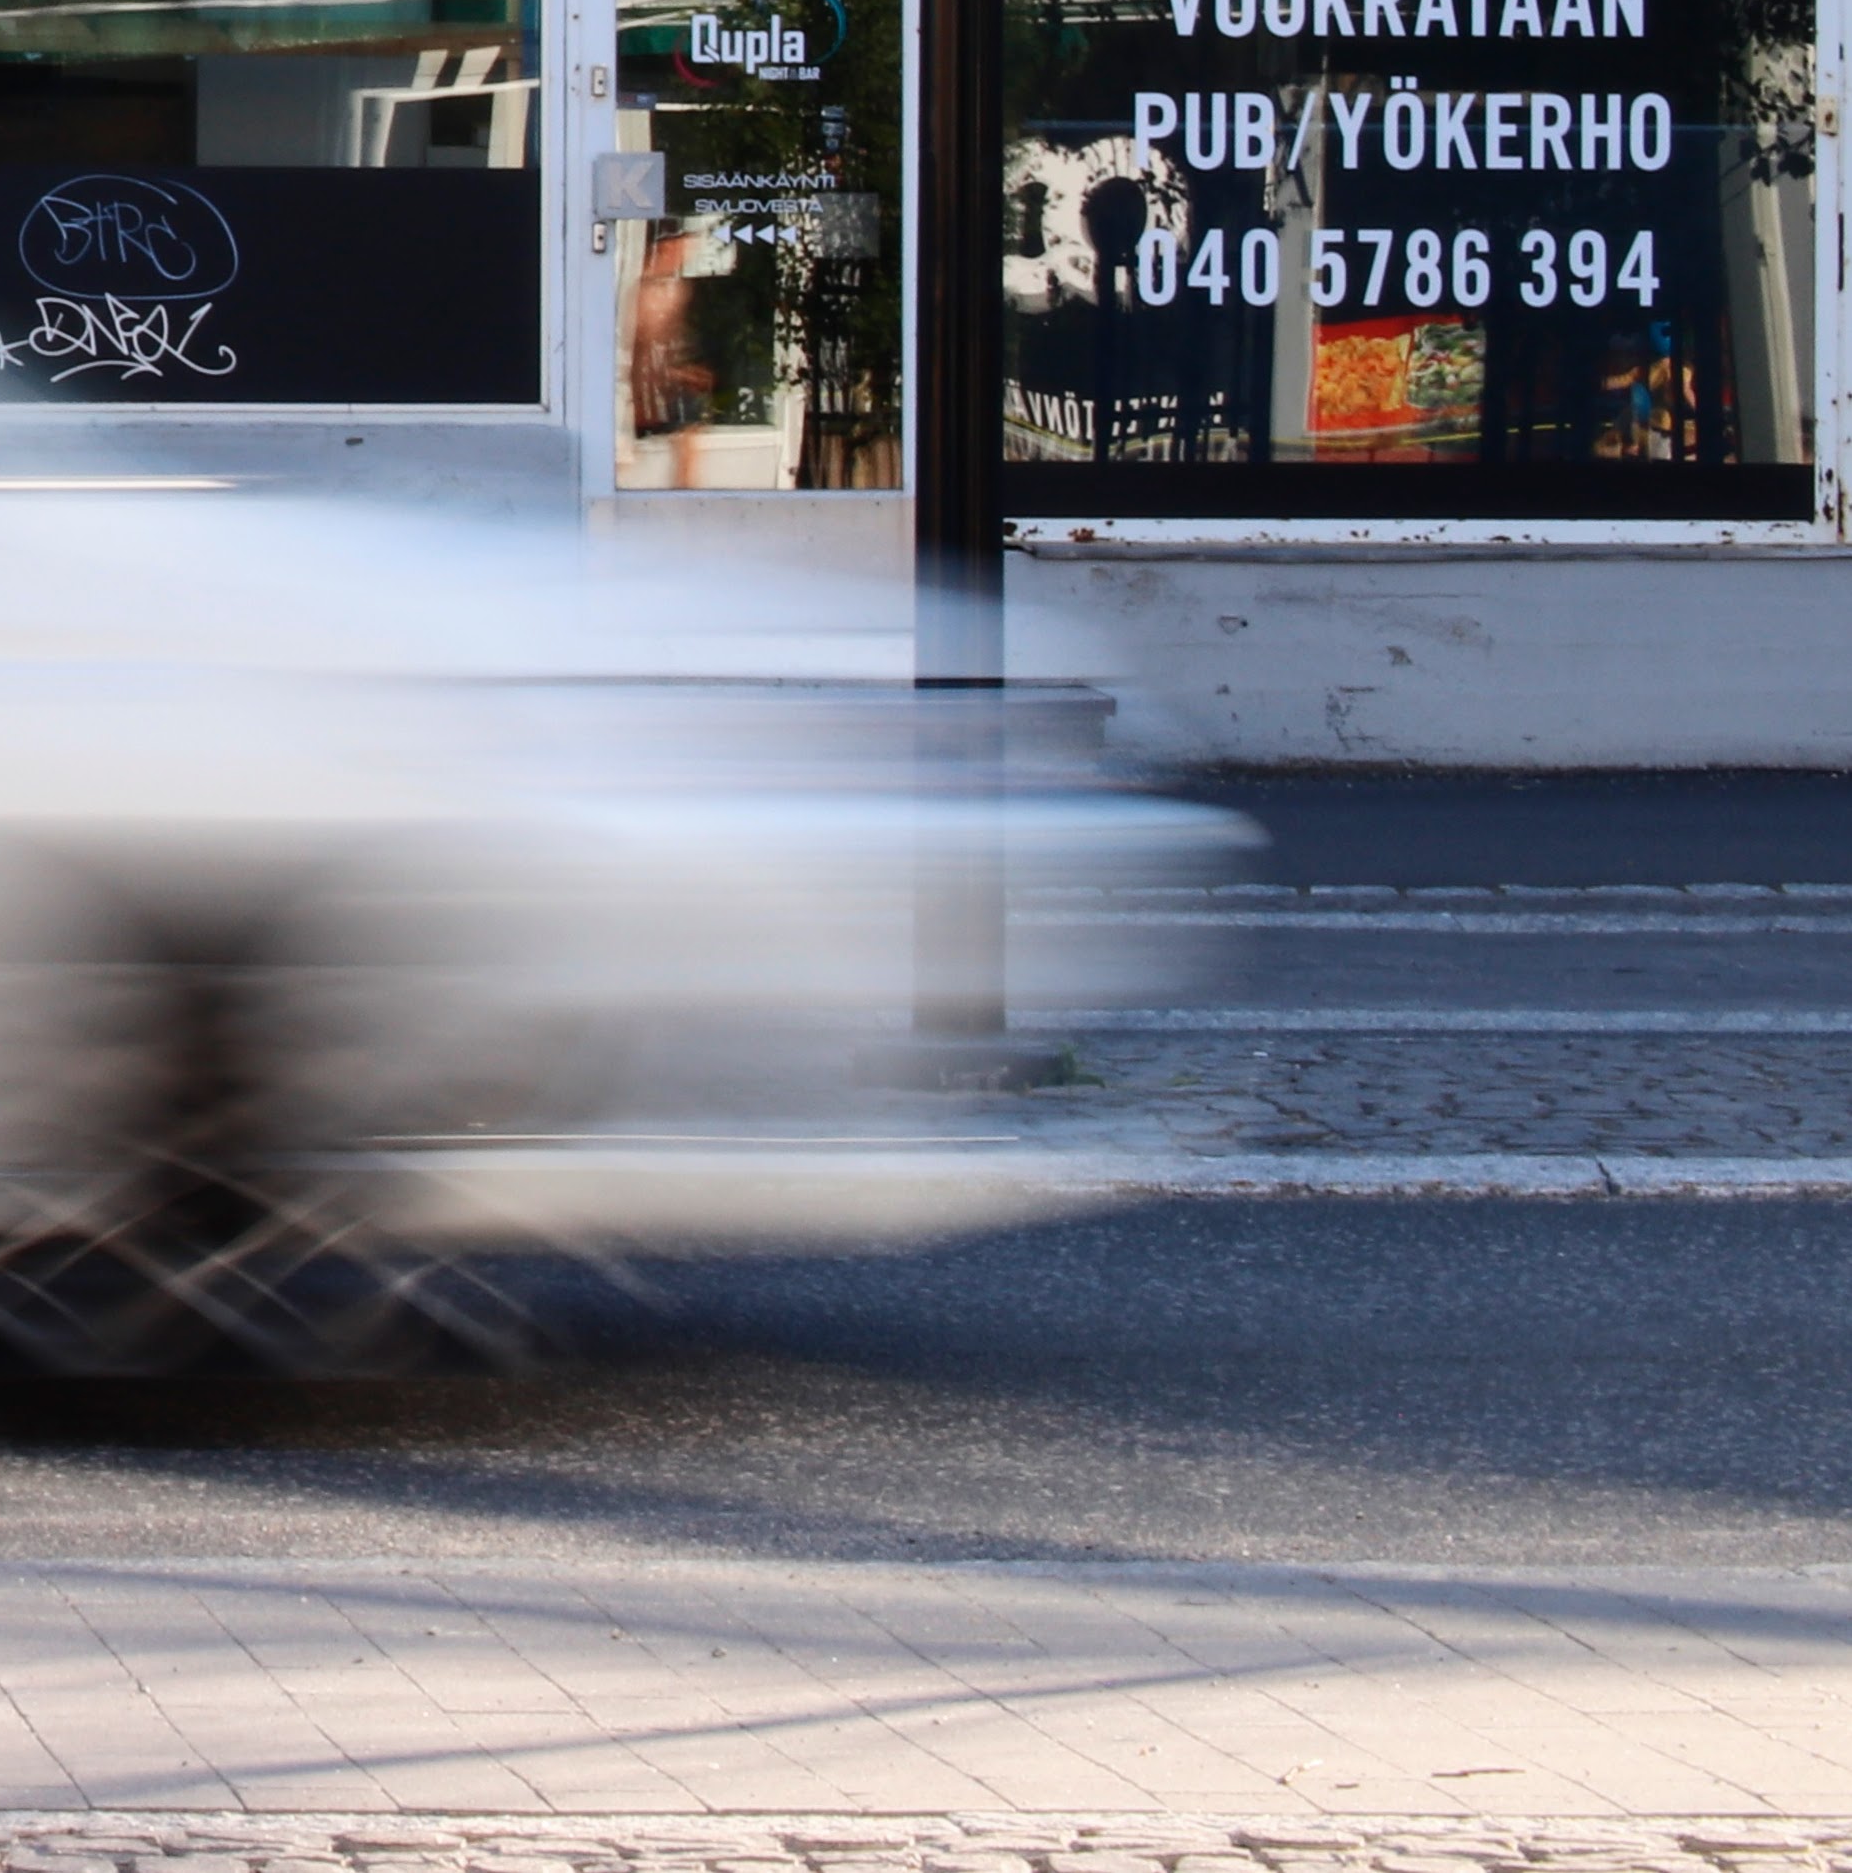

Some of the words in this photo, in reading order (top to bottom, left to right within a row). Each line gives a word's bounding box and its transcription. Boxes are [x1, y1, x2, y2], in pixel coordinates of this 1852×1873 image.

[691, 13, 806, 75] Qupla
[1134, 76, 1673, 171] PUB/YÖKERHO
[1138, 228, 1280, 307] 040
[1309, 228, 1492, 307] 5786
[1520, 228, 1660, 307] 394
